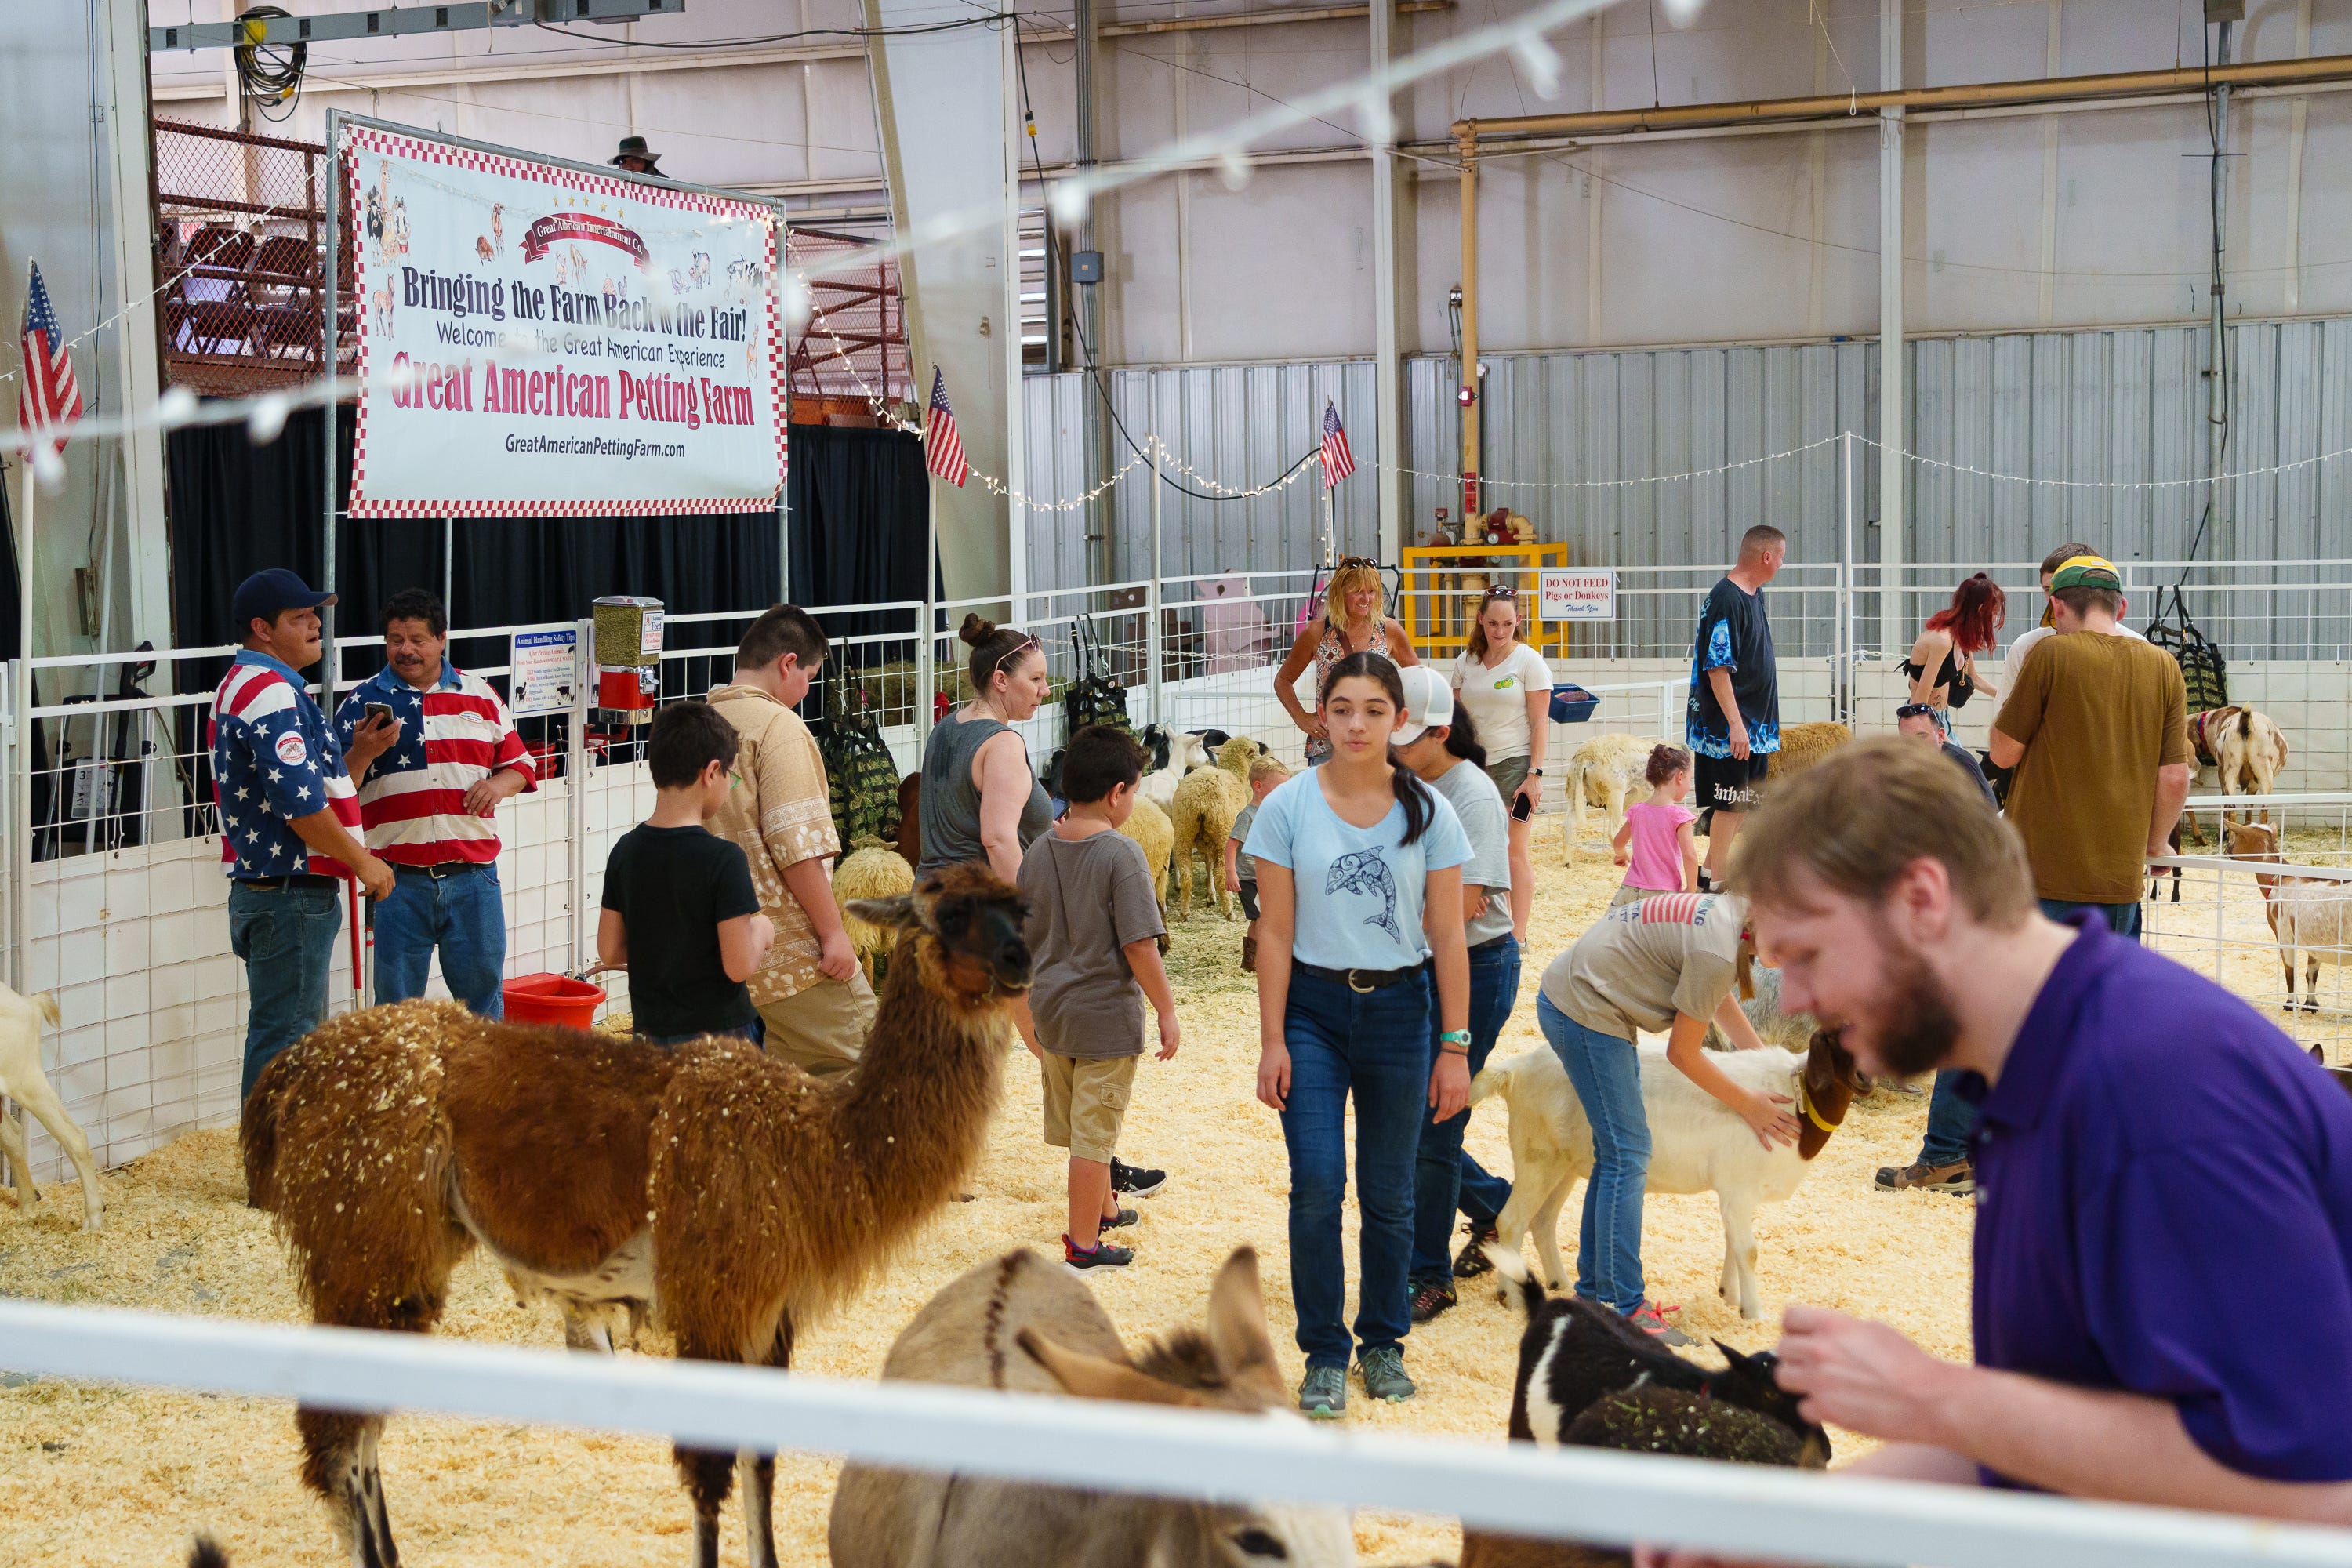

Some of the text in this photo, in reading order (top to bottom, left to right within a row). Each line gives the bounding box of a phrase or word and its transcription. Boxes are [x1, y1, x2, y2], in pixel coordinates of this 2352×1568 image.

[537, 218, 643, 255] Great American Entertainment Co.
[402, 266, 506, 321] Bringing
[511, 280, 546, 321] the
[550, 284, 603, 327] Farm
[603, 292, 655, 333] Back
[676, 301, 706, 339] the
[710, 305, 747, 343] Fair!
[436, 319, 506, 348] Welcome
[535, 328, 557, 354] the
[564, 332, 603, 358] Great
[608, 336, 664, 363] American
[667, 343, 726, 372] Experience
[391, 350, 755, 430] Great American Petting Farm
[505, 433, 685, 461] GreatAmericanPettingFarm.com
[1545, 578, 1609, 588] DO NOT FEED
[1545, 590, 1562, 602] Pigs
[1574, 590, 1609, 602] Donkeys
[1565, 604, 1599, 614] Thank You
[652, 621, 662, 630] Feed
[517, 633, 575, 645] Animal Handling Safety Tips
[79, 771, 86, 780] 3
